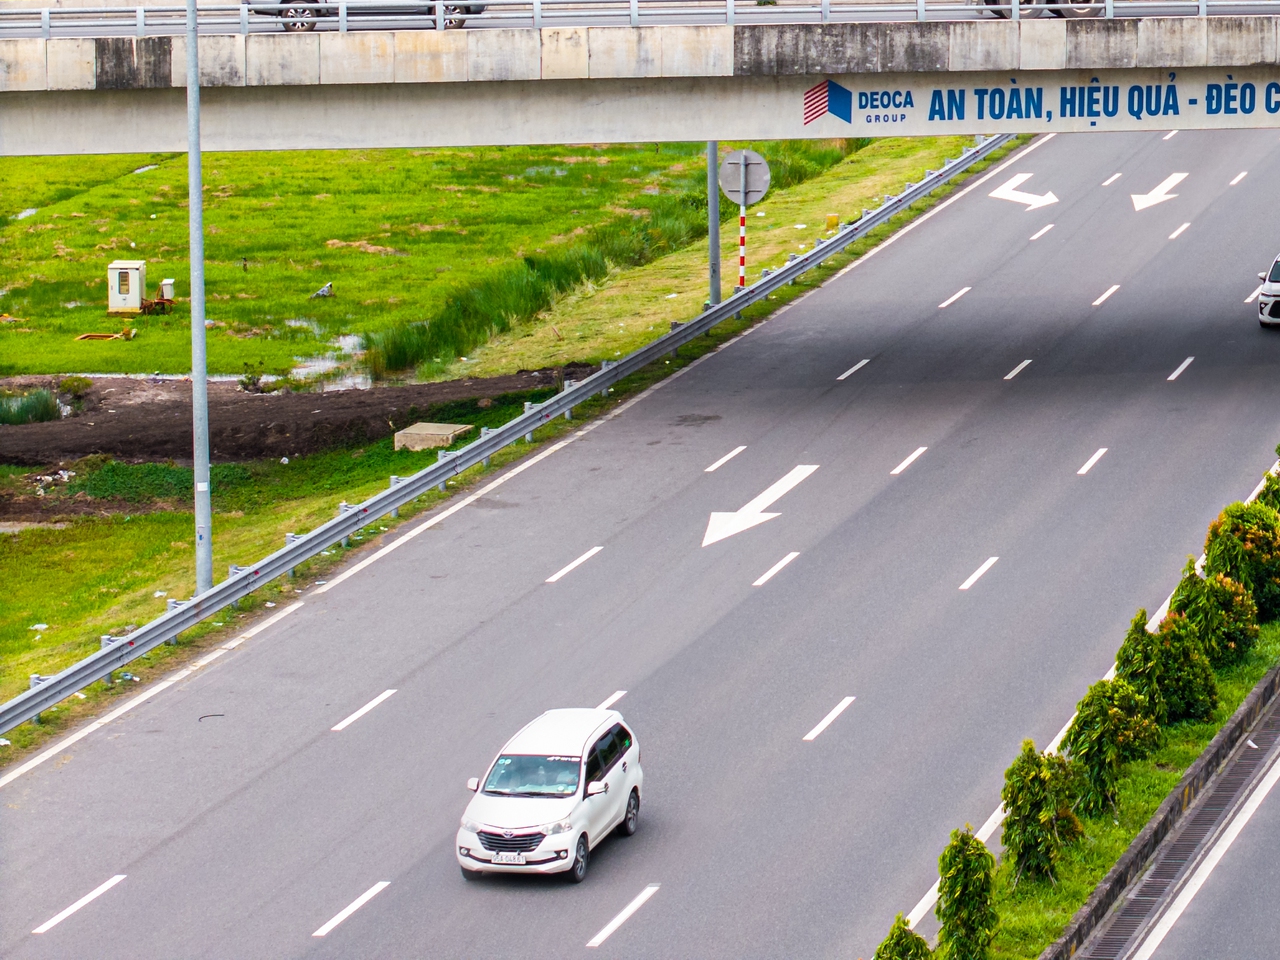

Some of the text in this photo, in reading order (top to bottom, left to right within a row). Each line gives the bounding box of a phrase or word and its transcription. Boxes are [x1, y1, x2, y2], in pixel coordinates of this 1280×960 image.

[859, 91, 914, 109] DEOCA
[928, 89, 965, 121] AN
[974, 78, 1053, 122] TOÀN,
[1060, 77, 1119, 126] HIỆU
[1127, 72, 1179, 120] QUẢ
[1206, 74, 1255, 114] ĐÈO
[866, 114, 906, 123] GROUP
